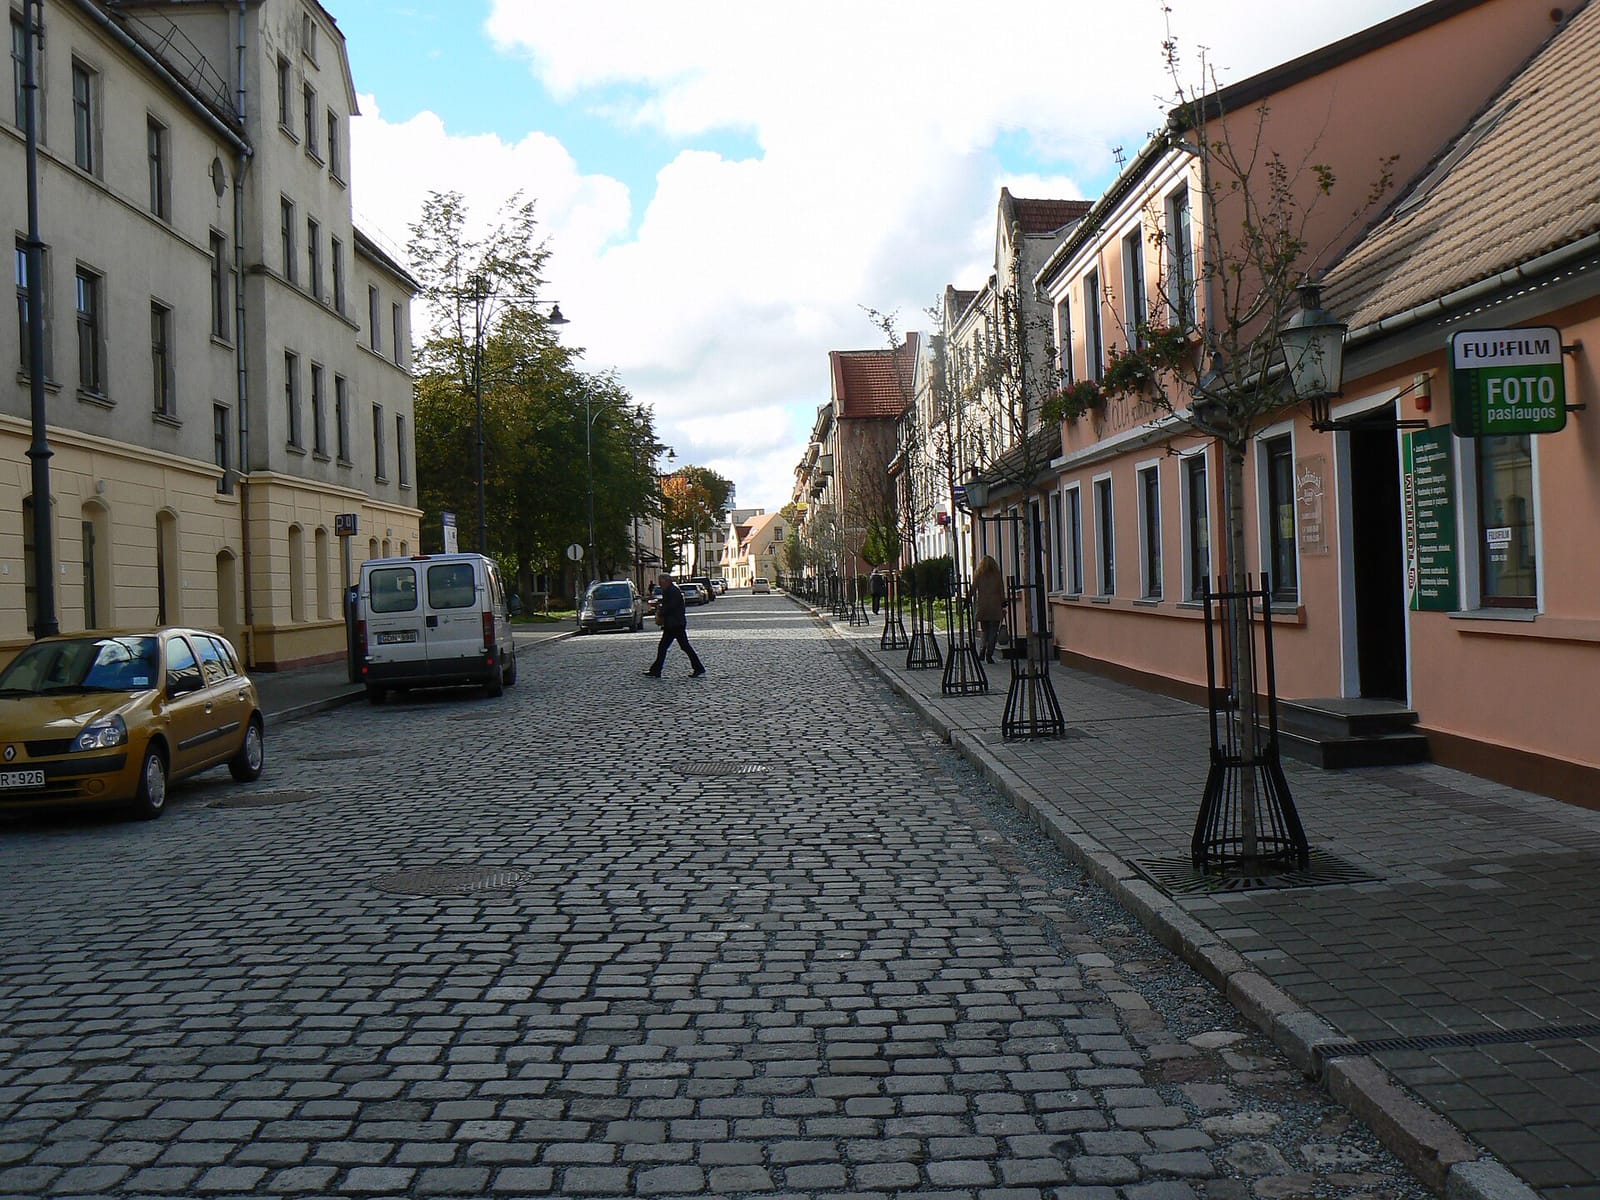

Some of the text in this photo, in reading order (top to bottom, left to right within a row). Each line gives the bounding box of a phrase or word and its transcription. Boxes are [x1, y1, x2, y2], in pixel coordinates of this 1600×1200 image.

[1463, 339, 1550, 358] FUJIFILM
[1487, 376, 1555, 405] FOTO
[1487, 405, 1557, 424] paslaugos
[18, 772, 43, 784] 926
